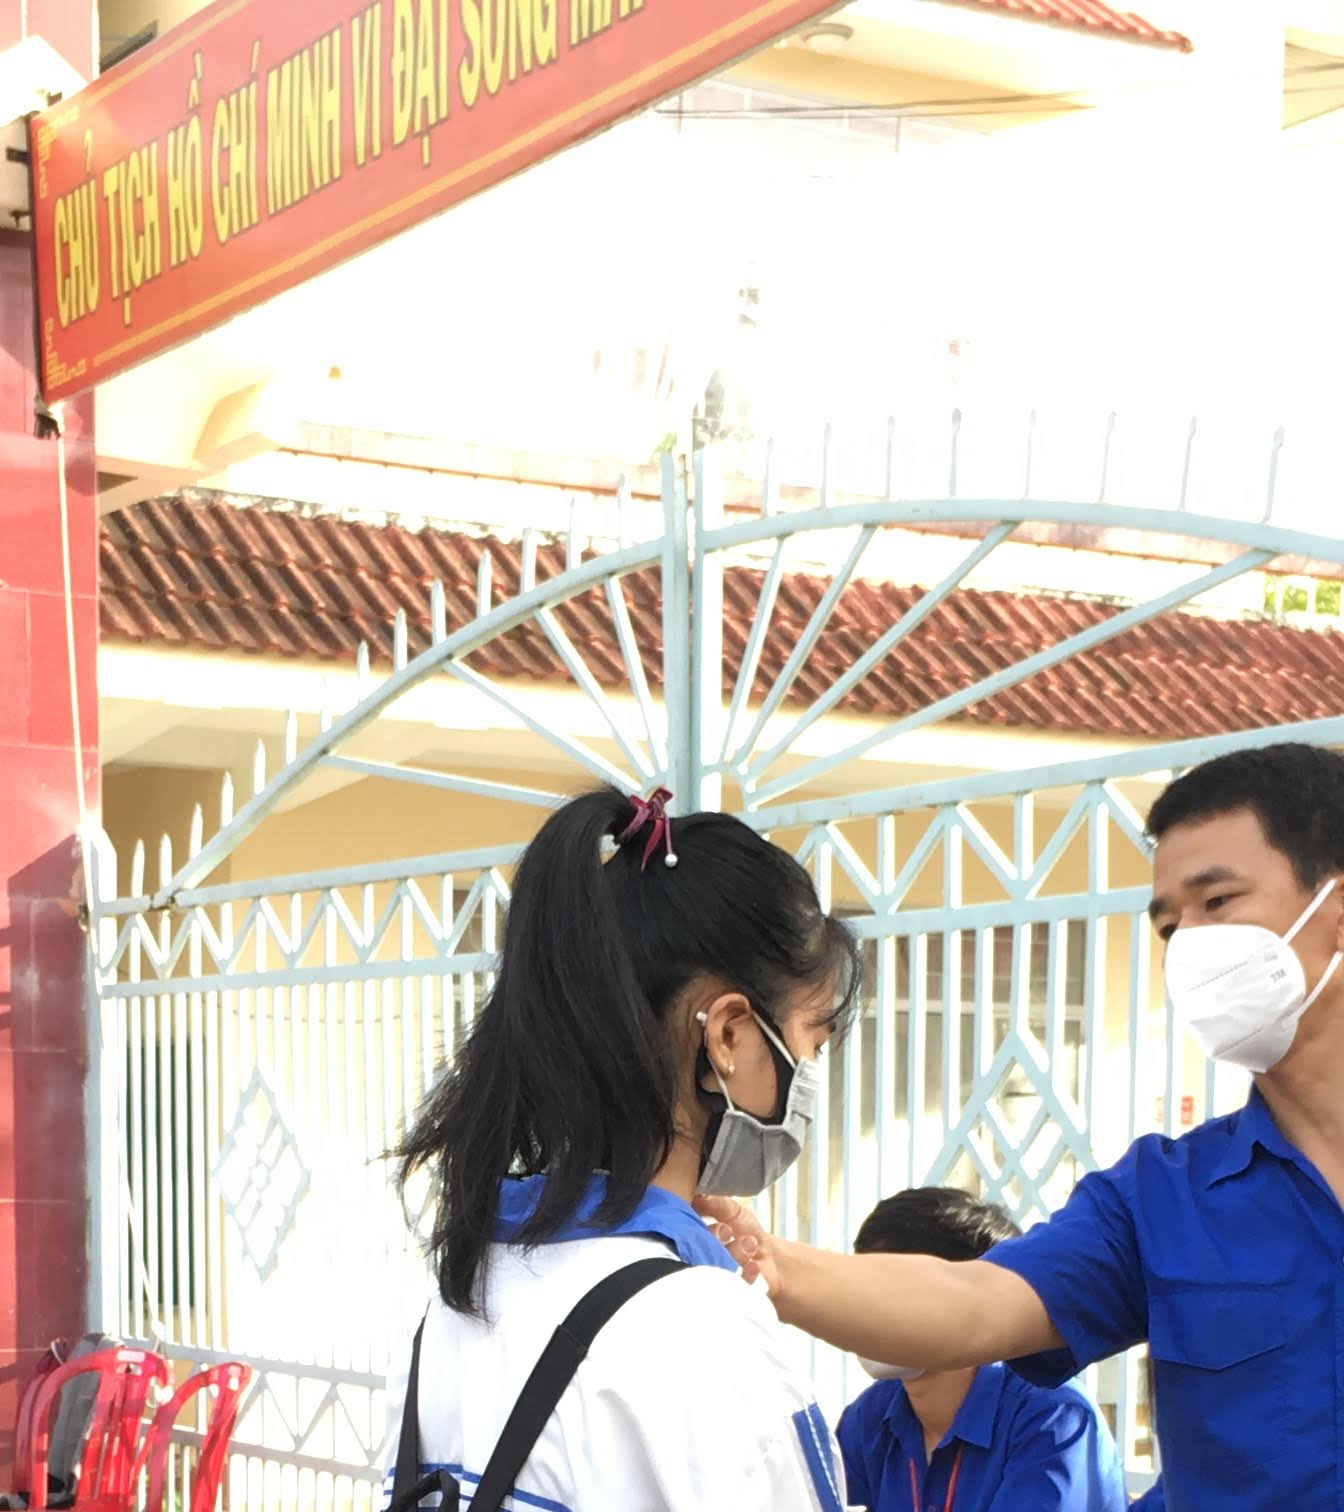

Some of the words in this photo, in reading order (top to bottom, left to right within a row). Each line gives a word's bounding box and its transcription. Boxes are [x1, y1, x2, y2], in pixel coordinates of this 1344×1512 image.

[54, 128, 99, 328] CHỦ
[103, 140, 161, 326] TỊCH
[168, 52, 203, 270] HỒ
[212, 40, 260, 244] CHÍ
[267, 24, 342, 218] MINH
[391, 0, 448, 167] ĐẠI
